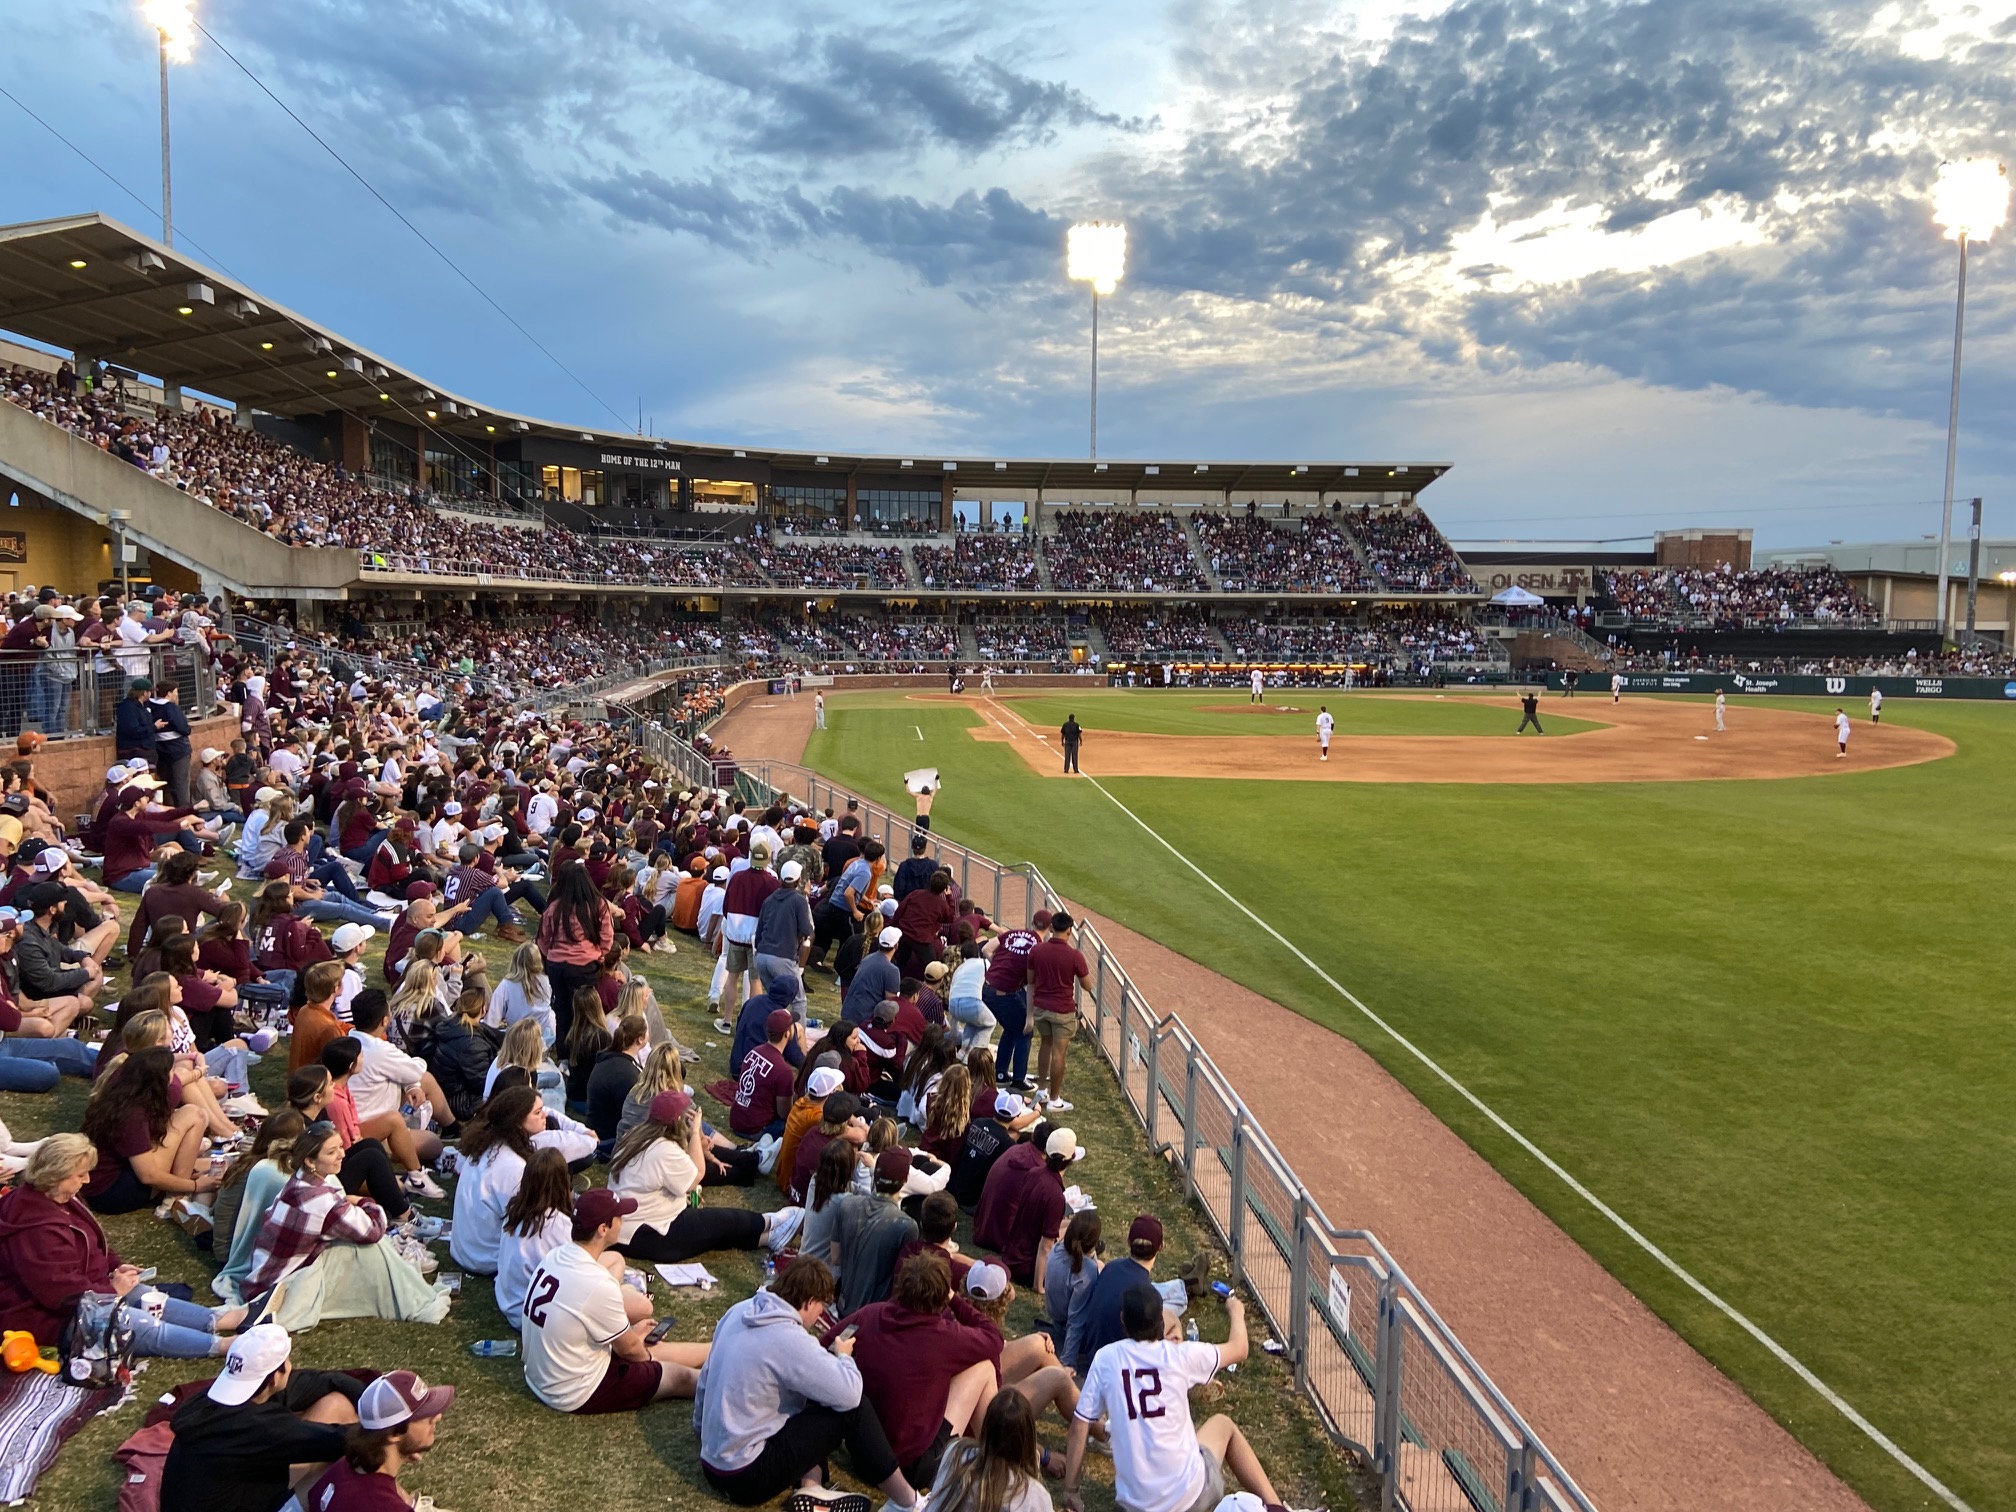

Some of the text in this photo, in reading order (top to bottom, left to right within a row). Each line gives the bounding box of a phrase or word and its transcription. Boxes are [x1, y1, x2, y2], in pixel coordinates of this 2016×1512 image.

[601, 453, 622, 465] HOME
[623, 456, 632, 465] OF
[634, 457, 649, 467] THE
[665, 460, 681, 470] MAN
[1491, 573, 1553, 589] OLSEN
[1755, 680, 1778, 688] Joseph
[1915, 686, 1943, 694] FARGO
[530, 801, 538, 815] 9
[444, 875, 460, 900] 12
[523, 1267, 560, 1329] 12
[1121, 1367, 1166, 1420] 12
